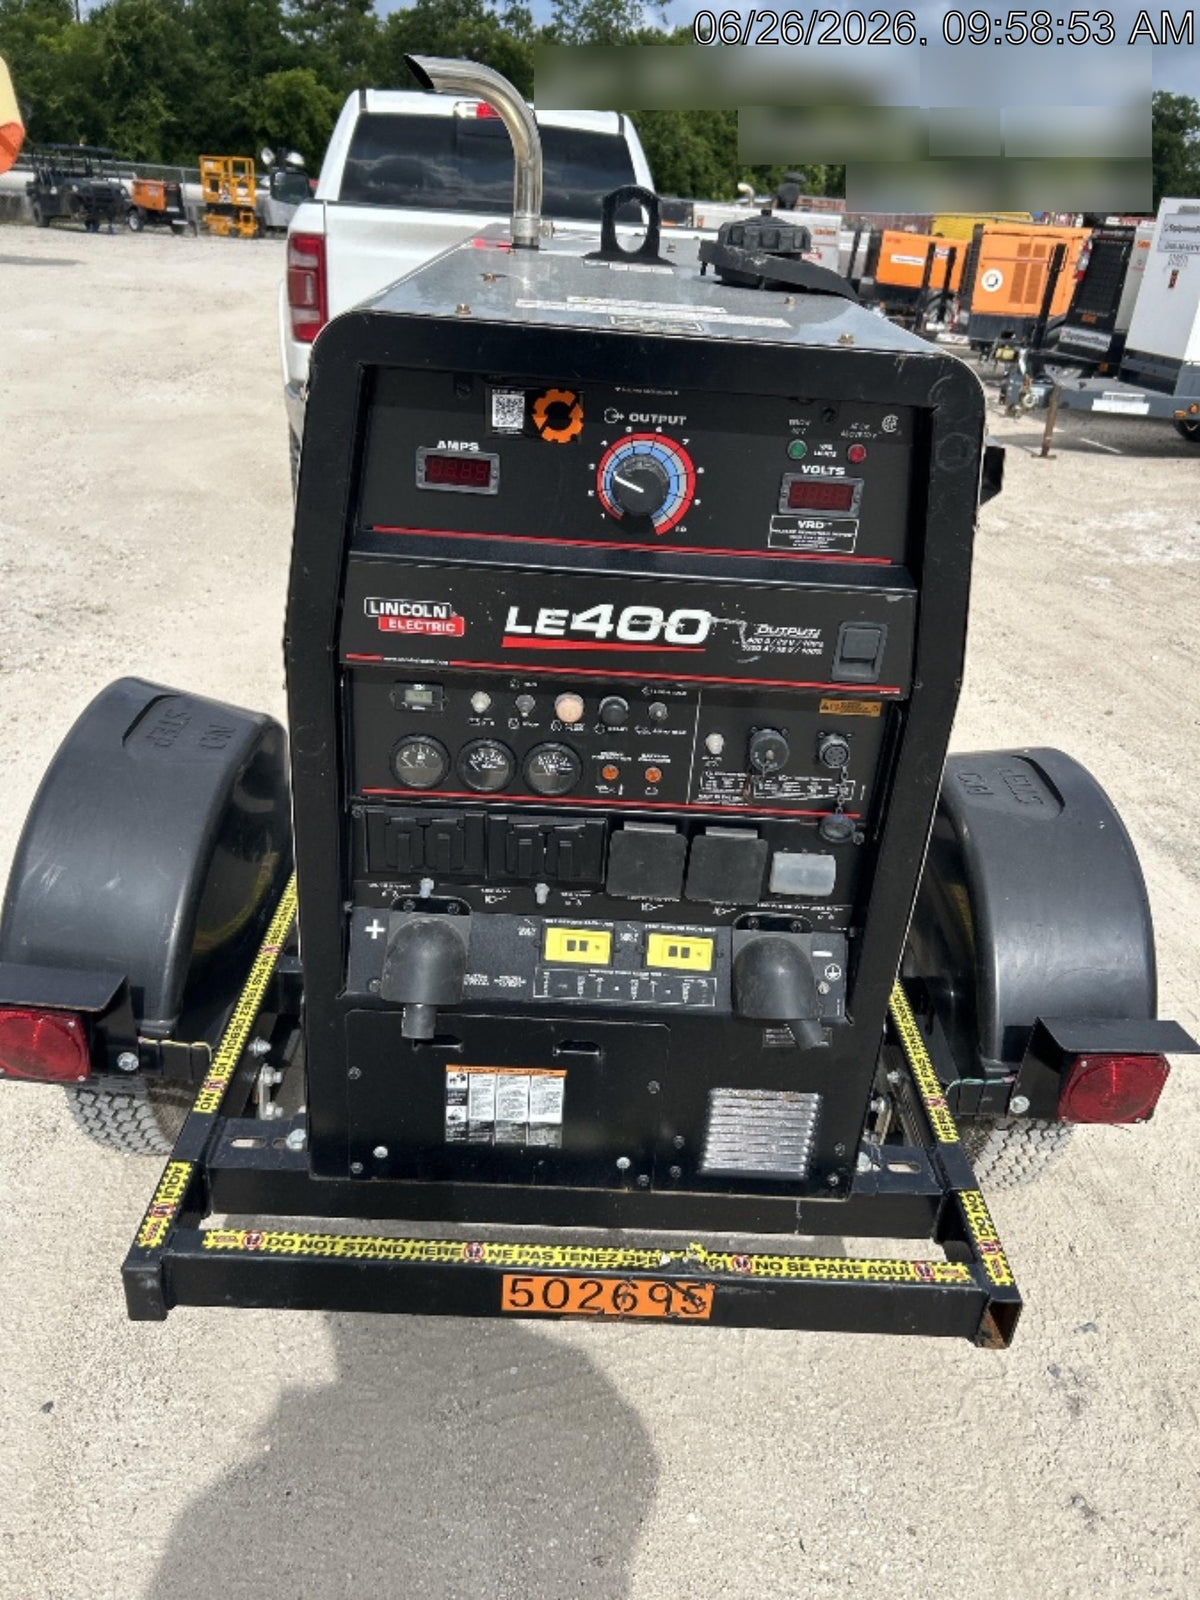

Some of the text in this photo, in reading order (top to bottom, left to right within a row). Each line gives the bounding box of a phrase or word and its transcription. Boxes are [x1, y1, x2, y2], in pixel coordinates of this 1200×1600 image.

[629, 413, 687, 426] OUTPUT
[437, 440, 480, 452] AMPS
[802, 465, 845, 476] VOLTS
[370, 600, 447, 619] LINCOLN
[388, 619, 456, 633] ELECTRIC
[504, 604, 712, 645] LE400
[222, 1019, 247, 1059] DEBOUT
[215, 1062, 229, 1076] ICI
[200, 1091, 215, 1109] NO
[975, 1217, 989, 1235] DO
[266, 1237, 462, 1258] DO NOT STAND HERE
[488, 1249, 514, 1260] NE
[518, 1250, 554, 1262] PAS
[558, 1251, 618, 1263] TENEZ
[755, 1261, 784, 1272] NO
[786, 1261, 811, 1273] SE
[815, 1263, 863, 1275] PARE
[508, 1278, 707, 1315] 502695
